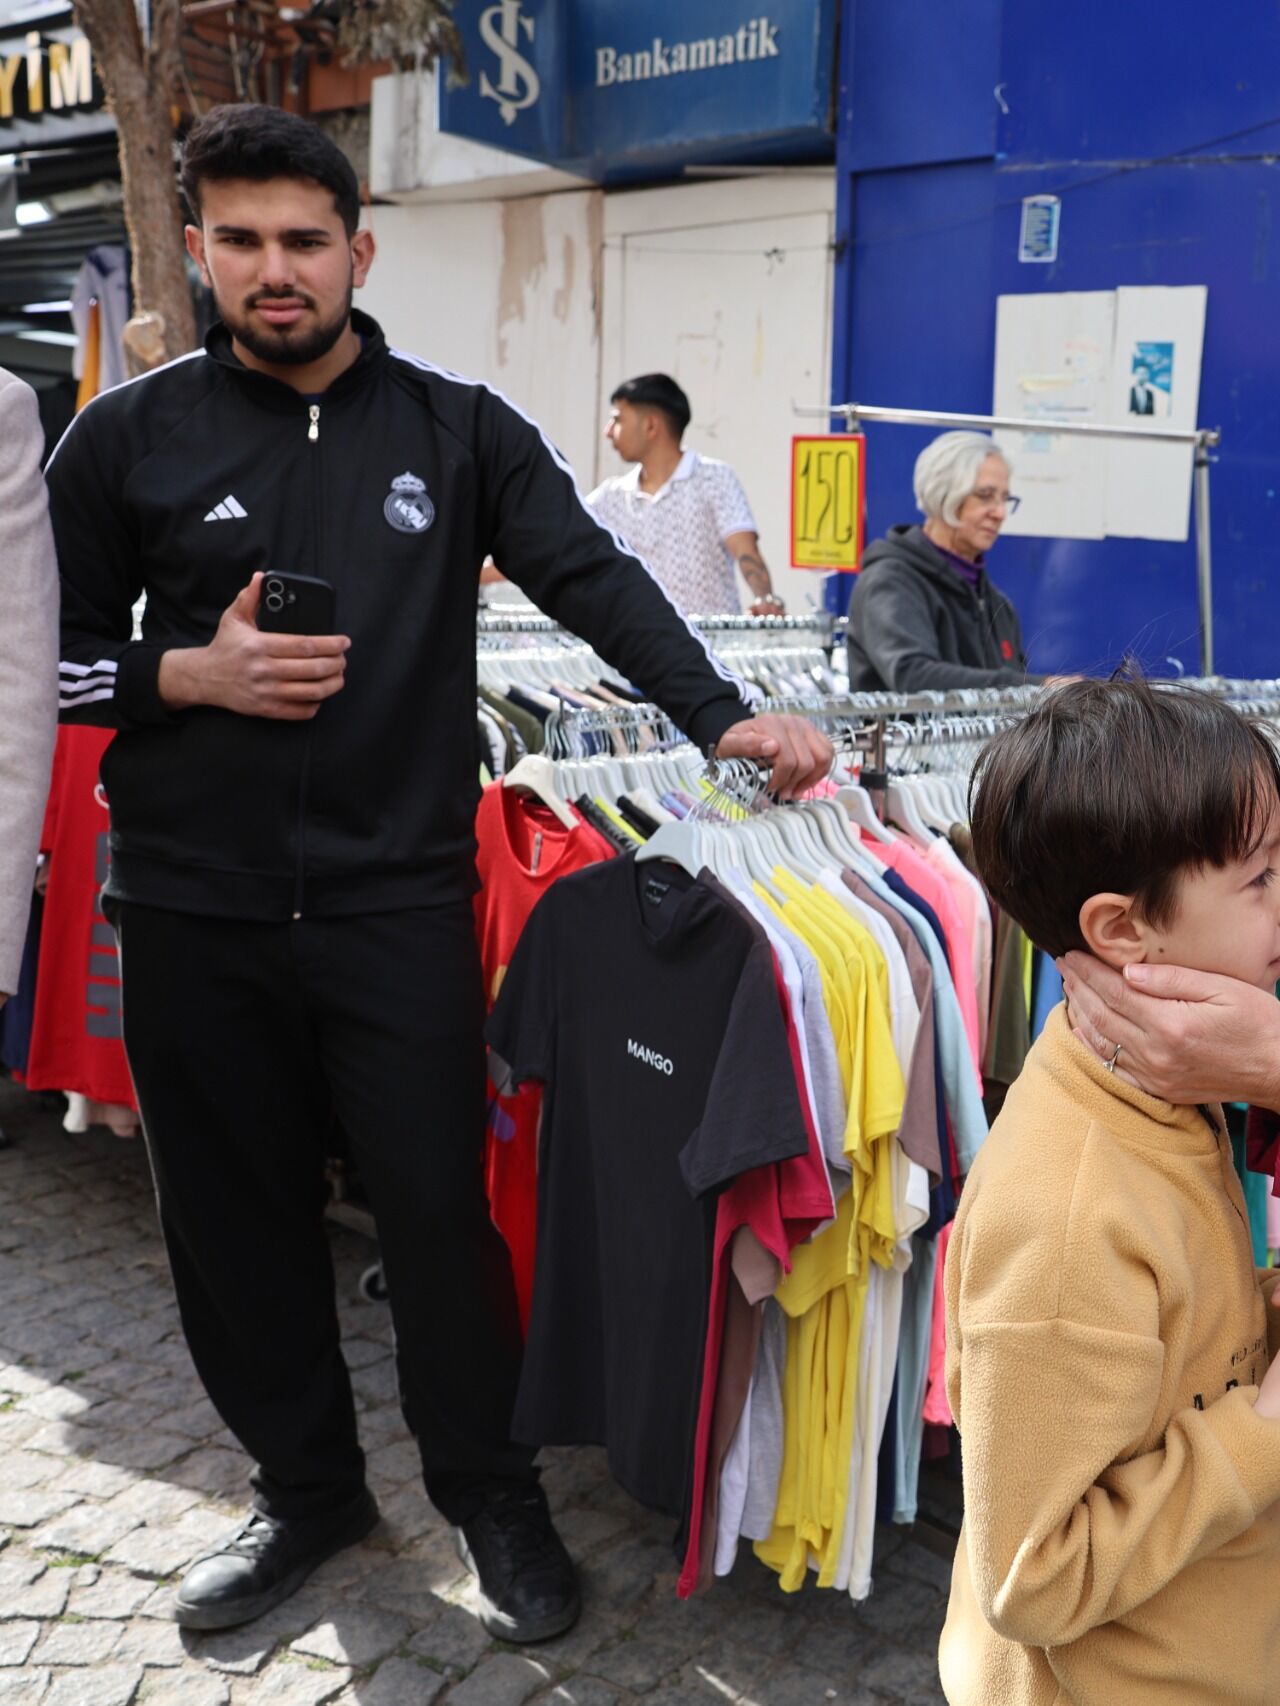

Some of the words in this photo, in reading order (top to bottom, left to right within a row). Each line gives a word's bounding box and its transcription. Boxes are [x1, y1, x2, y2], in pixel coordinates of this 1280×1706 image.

[597, 17, 779, 86] Bankamatik
[797, 449, 854, 544] 150
[627, 1038, 674, 1076] MANGO
